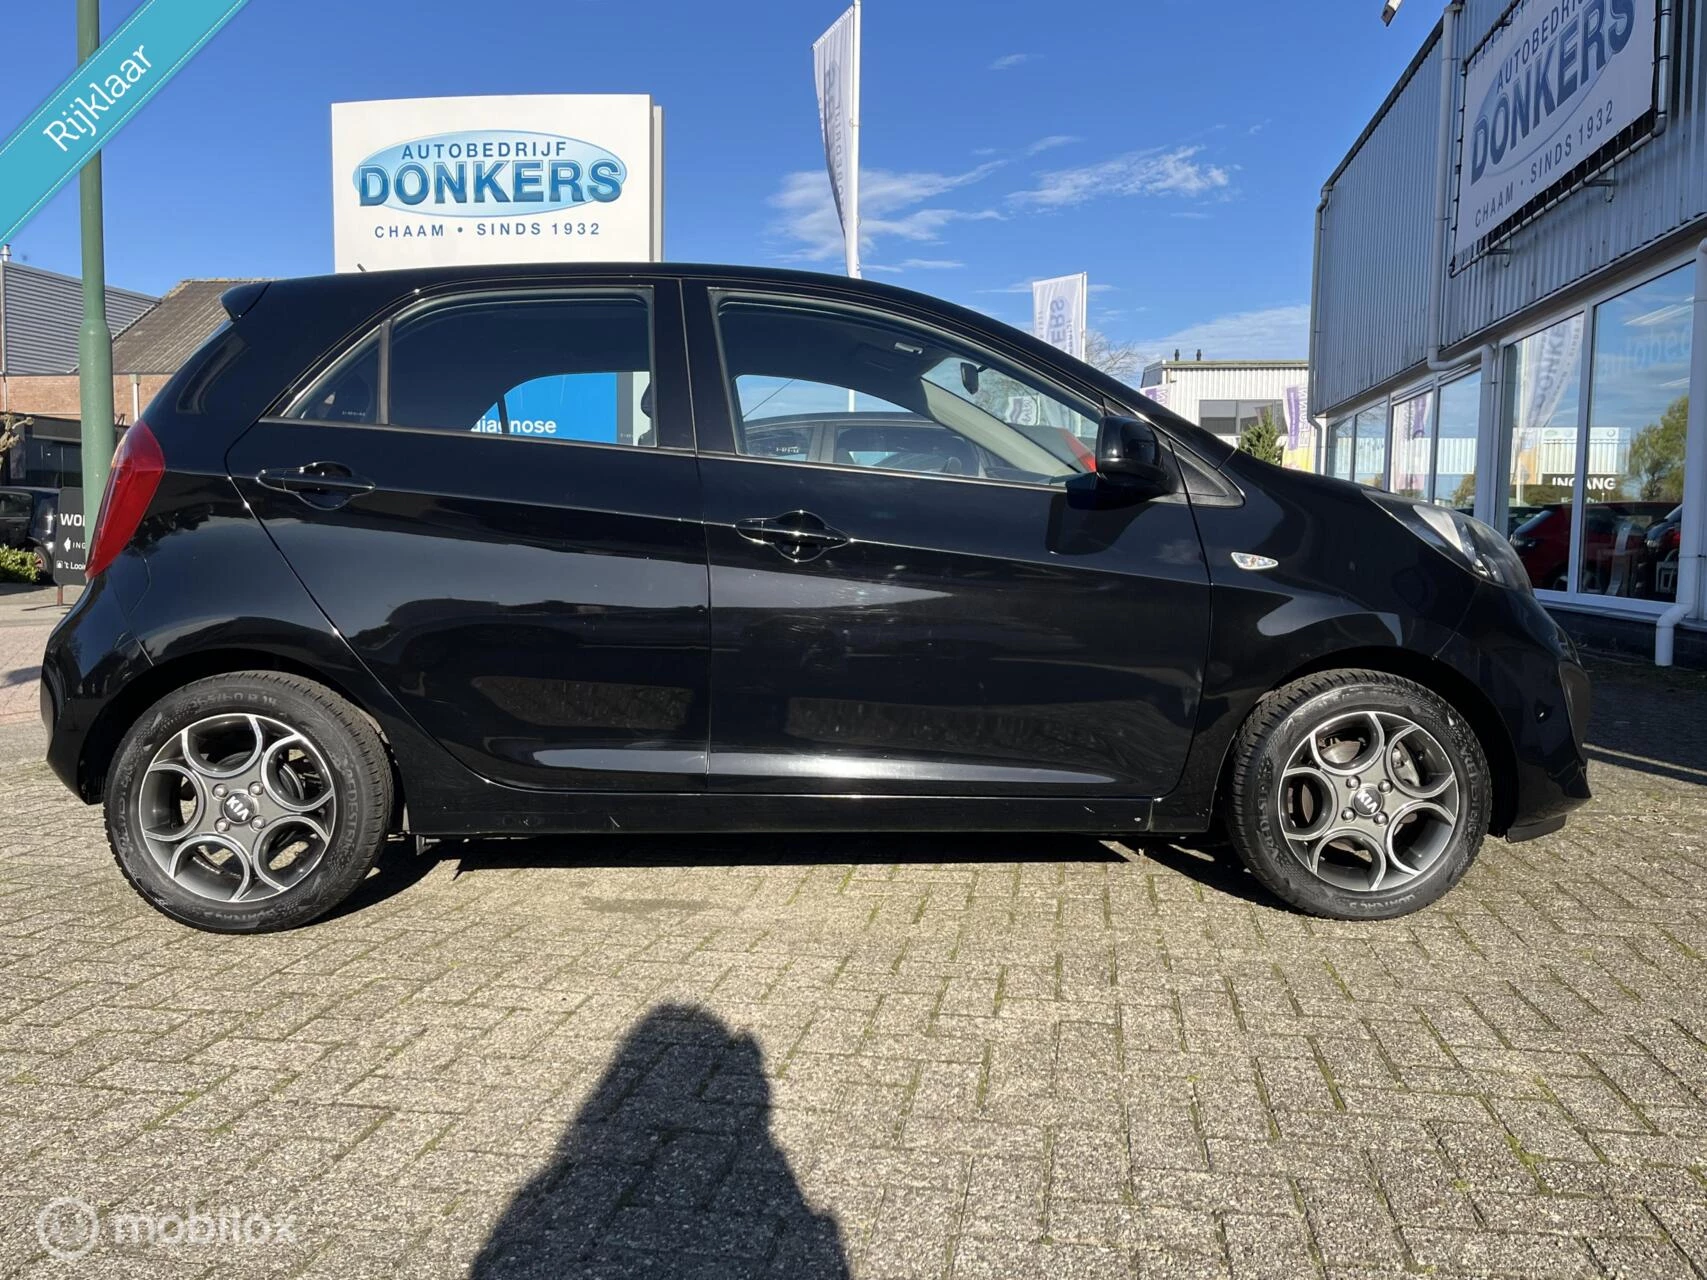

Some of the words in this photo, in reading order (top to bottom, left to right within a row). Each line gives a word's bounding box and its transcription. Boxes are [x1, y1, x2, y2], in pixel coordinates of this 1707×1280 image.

[1496, 0, 1584, 94] AUTOBEDR
[1470, 0, 1635, 186] DONKERS
[401, 142, 567, 159] AUTOBEDRIJF
[1474, 181, 1513, 228] CHAAM
[1530, 133, 1572, 184] SINDS
[1578, 99, 1613, 146] 1932
[359, 159, 623, 206] DONKERS
[374, 224, 444, 238] CHAAM
[476, 223, 541, 236] SINDS
[551, 222, 600, 235] 1932
[470, 415, 557, 434] dianose
[226, 796, 250, 821] KIA
[1356, 789, 1378, 813] KIA
